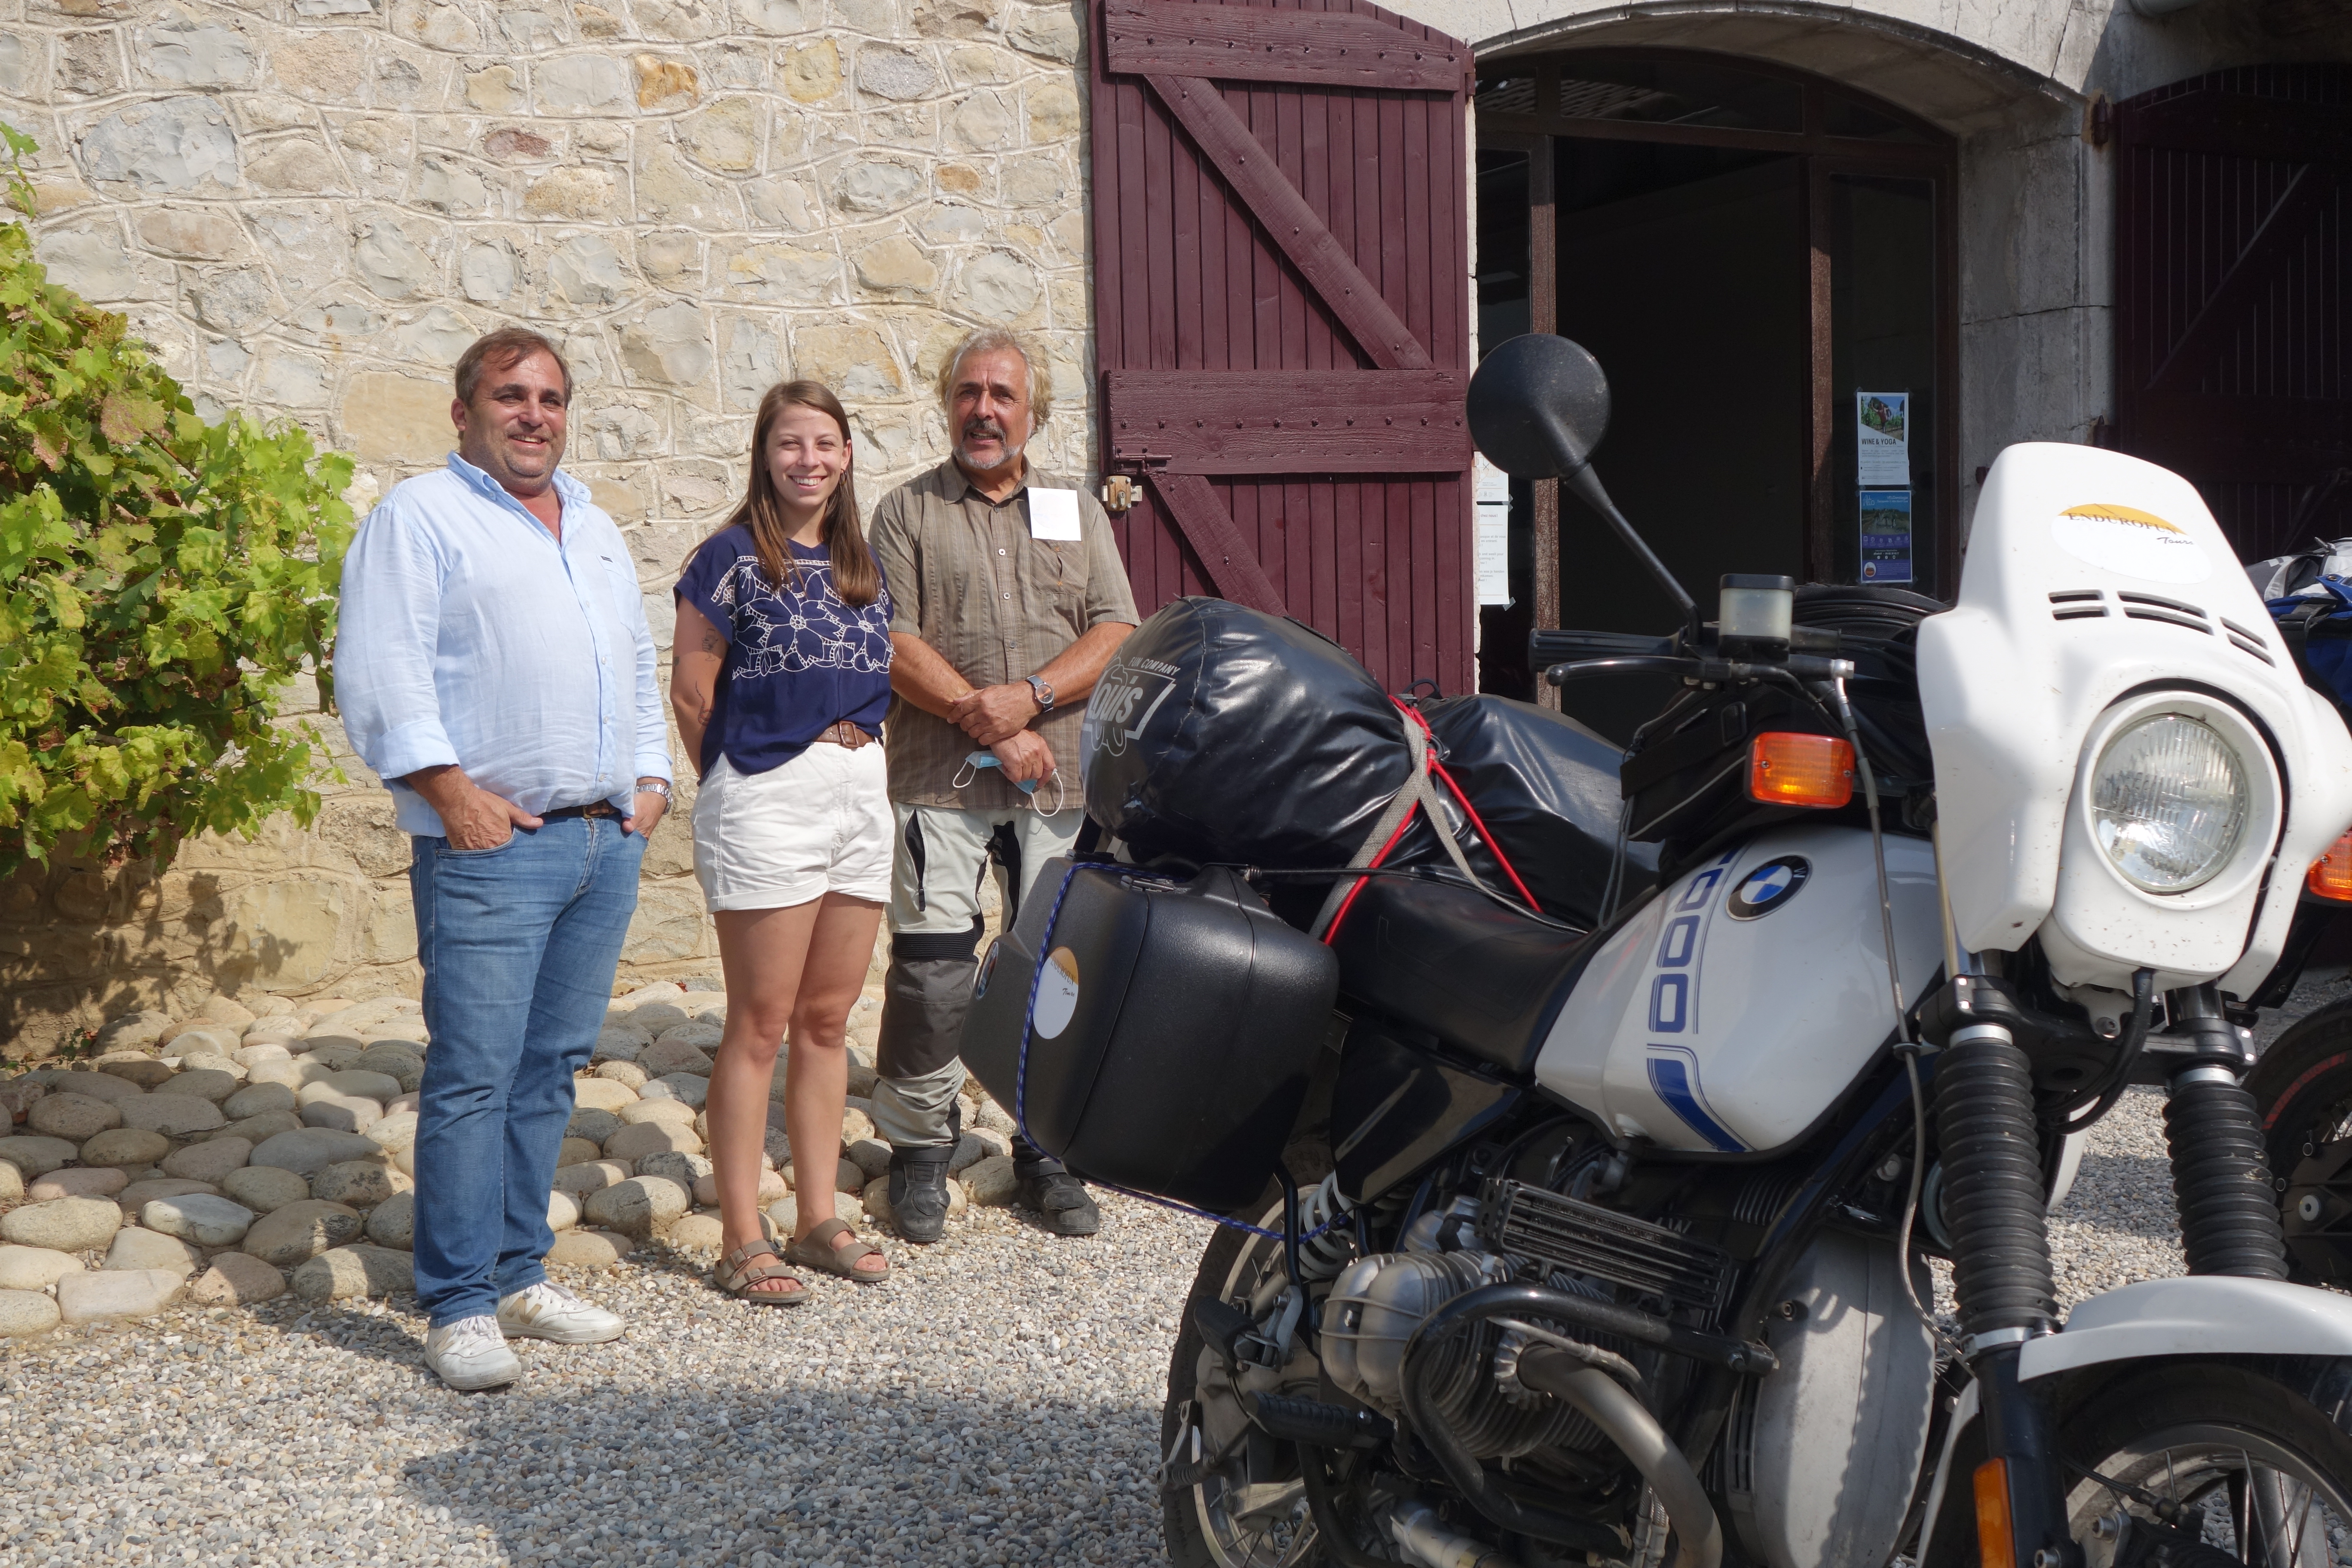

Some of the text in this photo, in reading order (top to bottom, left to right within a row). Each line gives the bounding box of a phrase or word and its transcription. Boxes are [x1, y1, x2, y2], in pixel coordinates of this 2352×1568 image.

[2067, 512, 2177, 536] ENDUROFUN
[2156, 536, 2195, 545] Tours
[1128, 656, 1181, 676] FUN COMPANY
[1086, 673, 1143, 723] Louis
[1050, 956, 1076, 986] ENDUROFUN
[1062, 988, 1075, 997] Tours
